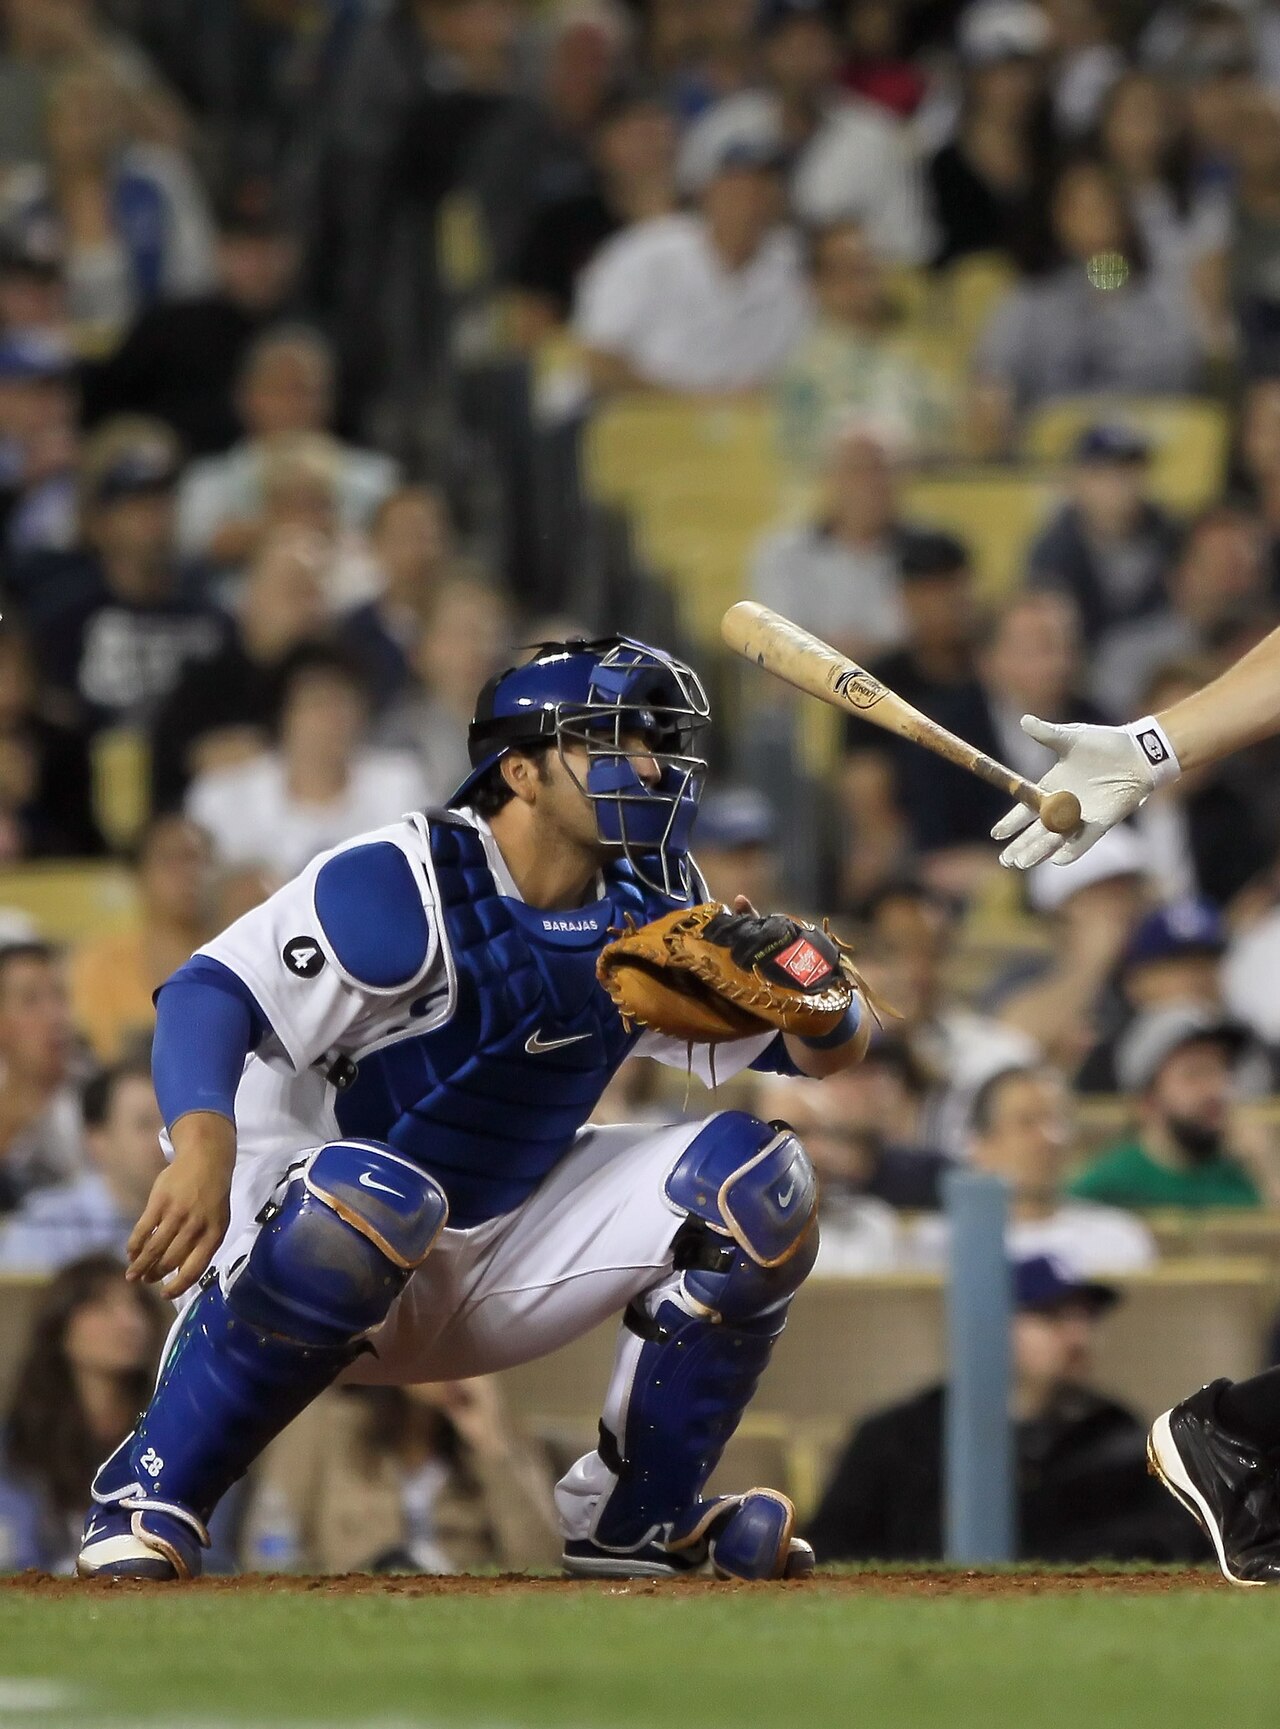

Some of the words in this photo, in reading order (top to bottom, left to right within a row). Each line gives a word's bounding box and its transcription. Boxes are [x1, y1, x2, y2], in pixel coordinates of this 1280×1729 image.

[542, 919, 598, 932] BARAJAS
[290, 948, 317, 969] 4
[140, 1447, 164, 1477] 28
